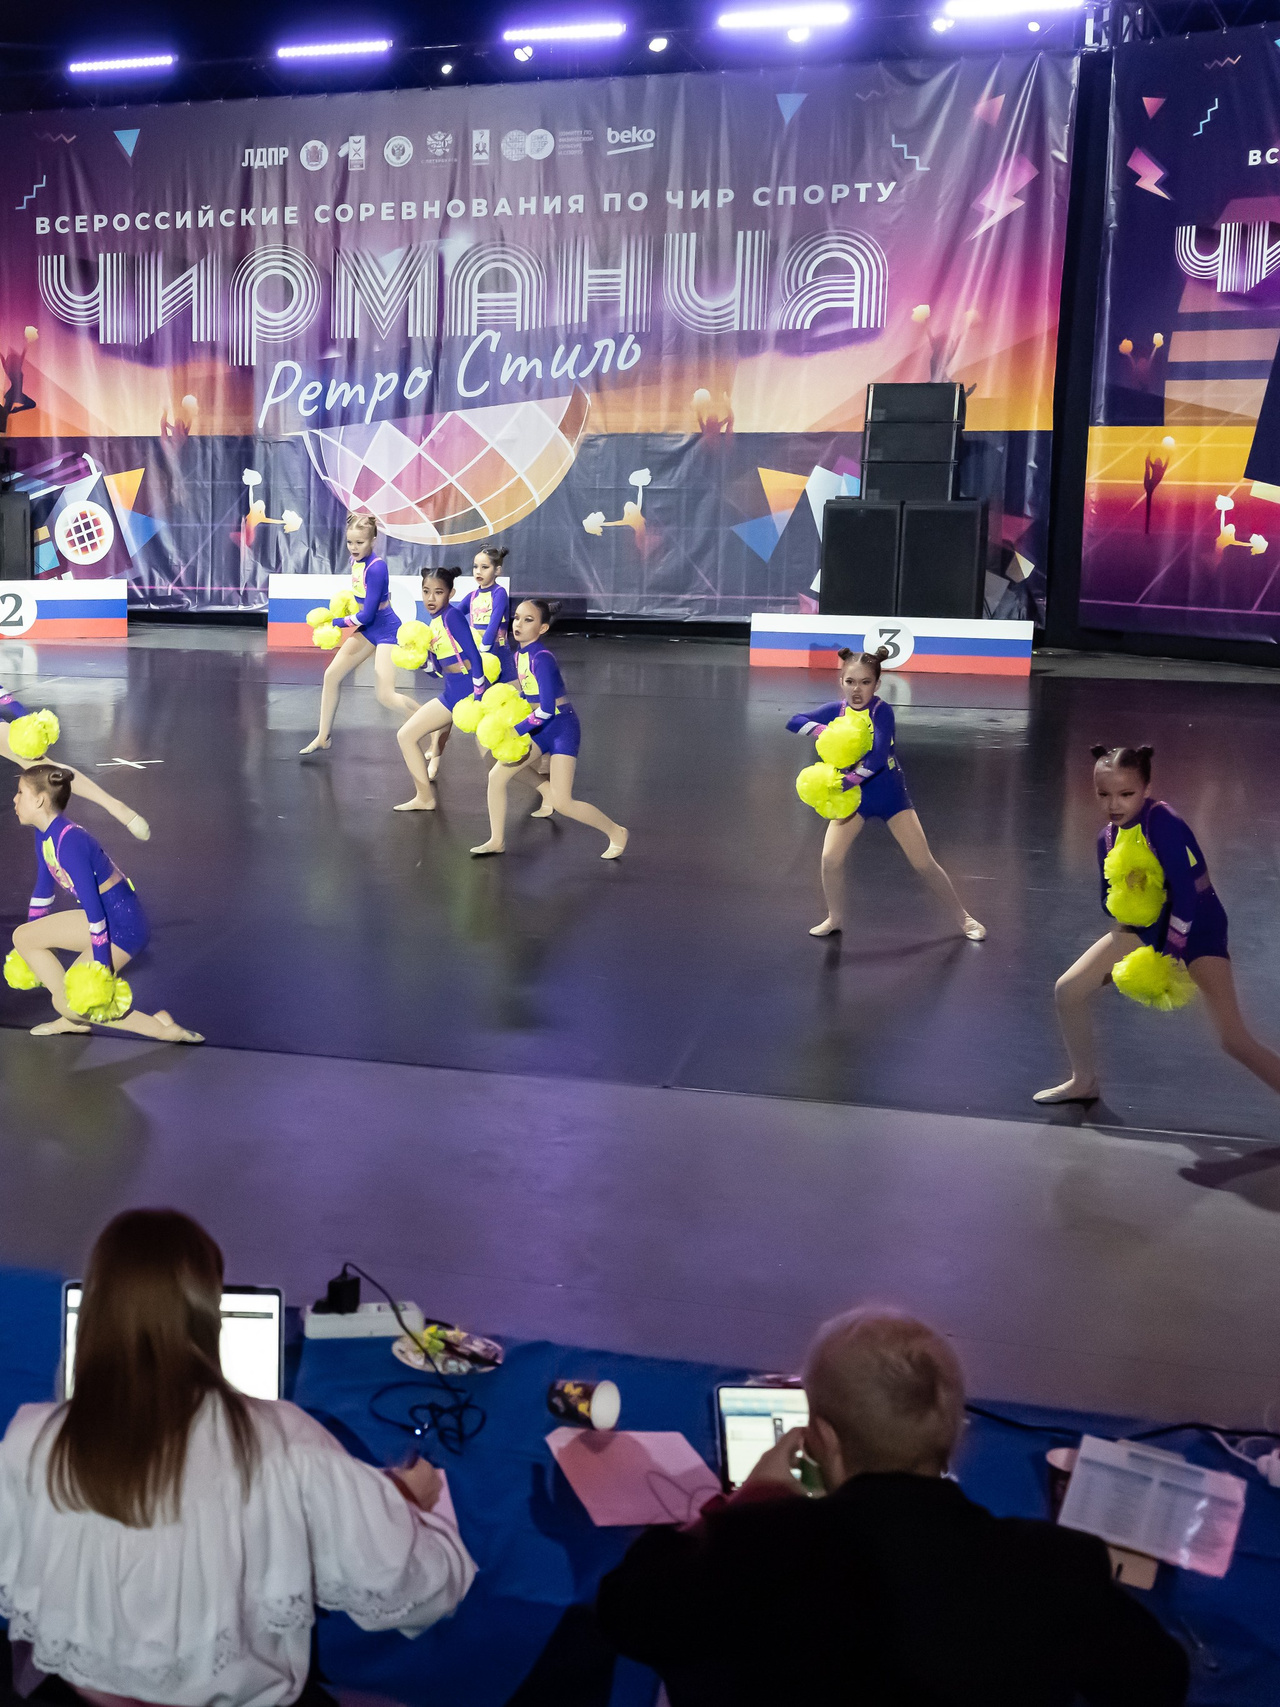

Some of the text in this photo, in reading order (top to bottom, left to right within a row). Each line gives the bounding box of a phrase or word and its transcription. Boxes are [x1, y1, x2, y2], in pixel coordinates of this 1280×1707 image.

[606, 126, 656, 146] beko
[241, 147, 289, 168] ЛДПР
[35, 181, 898, 235] ВСЕРОССИЙСКИЕ СОРЕВНОВАНИЯ ПО ЧИР СПОРТУ
[257, 329, 642, 429] Ретро Стиль
[0, 593, 24, 627] 2
[878, 628, 901, 659] 3
